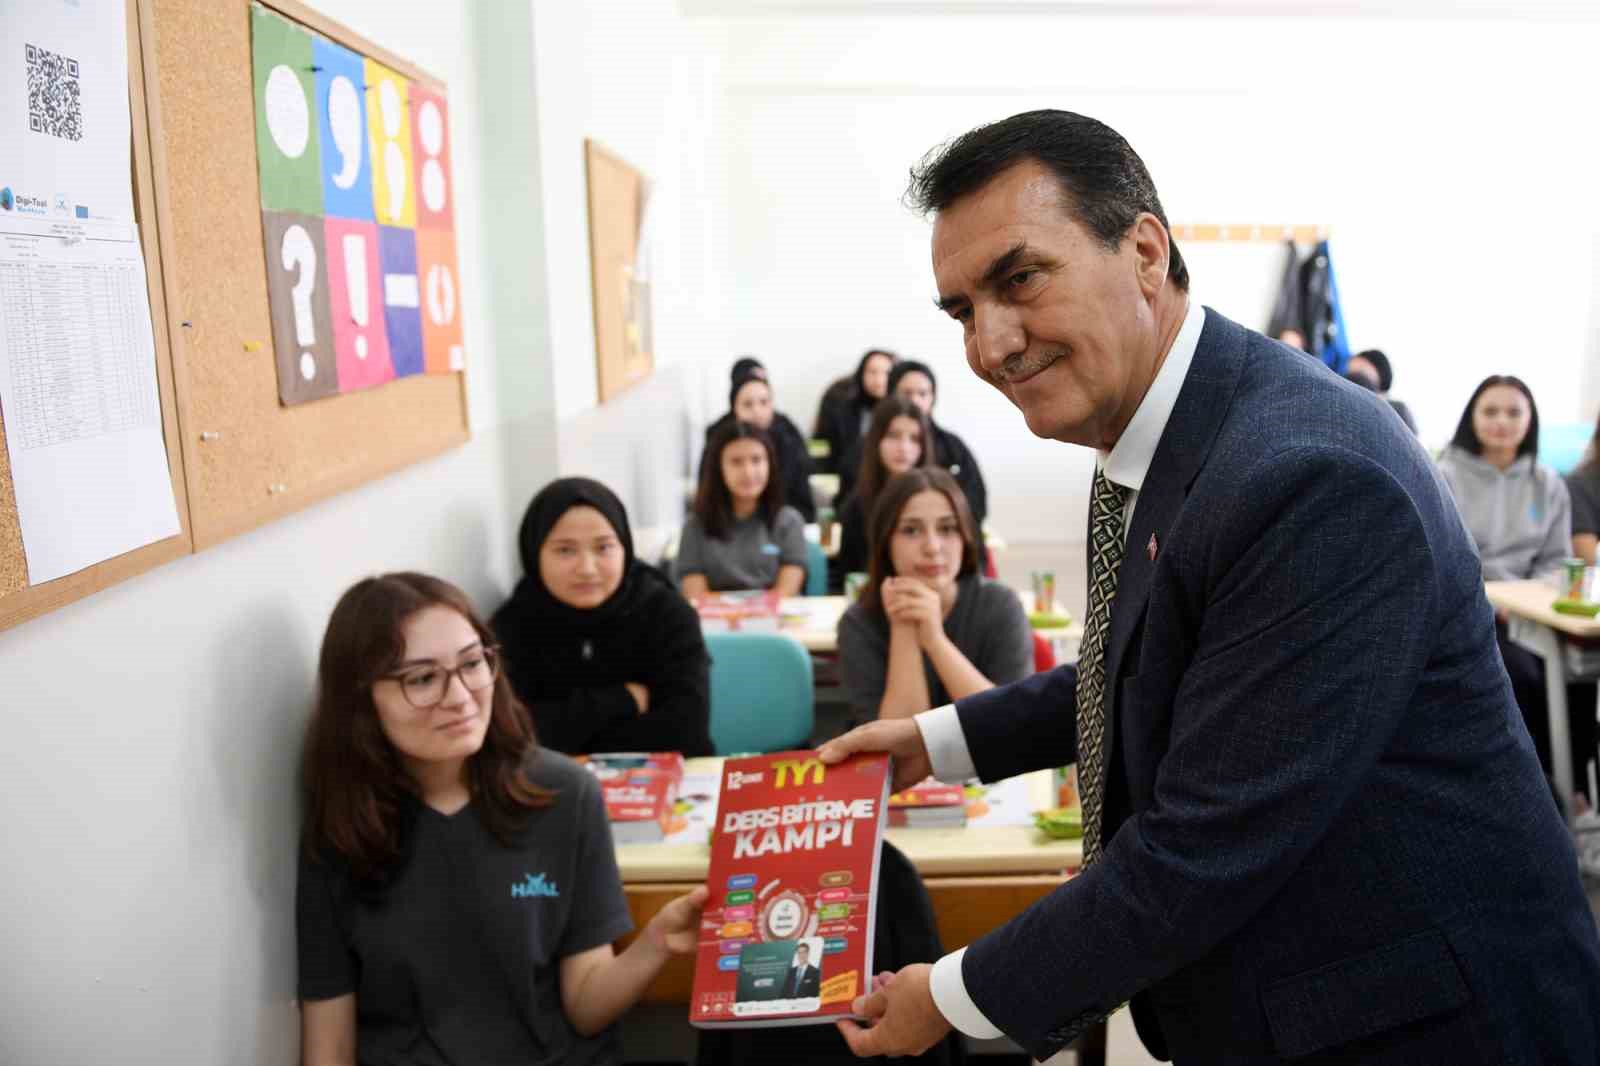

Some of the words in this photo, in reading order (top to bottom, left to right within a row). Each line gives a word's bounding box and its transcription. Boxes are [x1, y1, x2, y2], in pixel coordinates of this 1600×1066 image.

[281, 224, 317, 381] ?
[723, 806, 780, 833] DERS
[781, 795, 875, 826] BİTİRME
[733, 818, 854, 860] KAMPI
